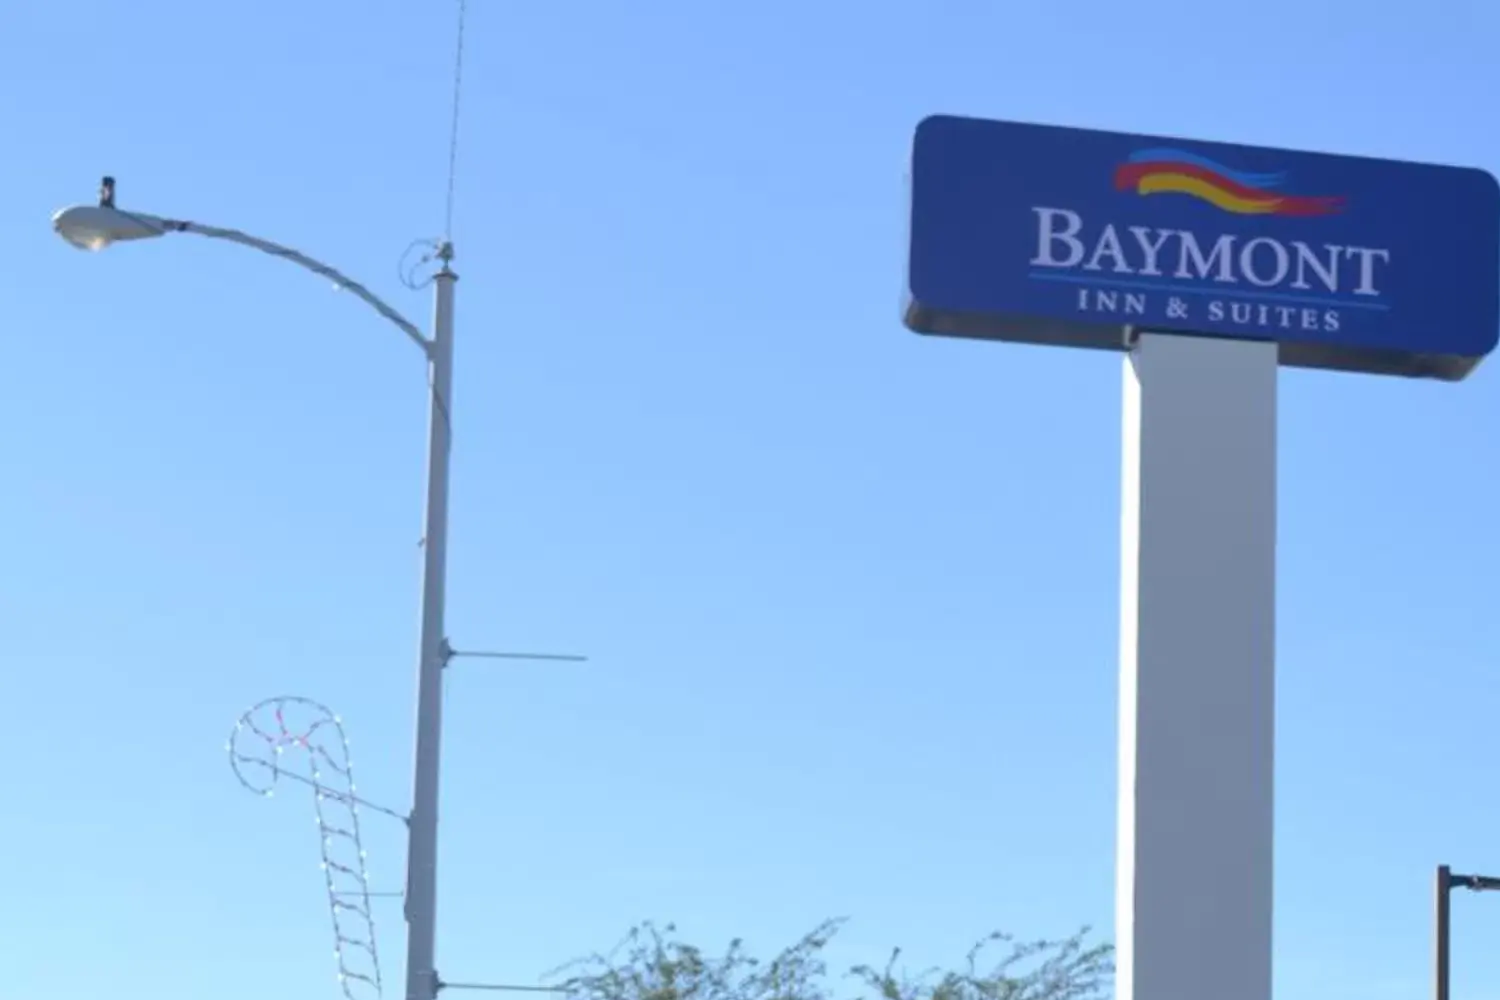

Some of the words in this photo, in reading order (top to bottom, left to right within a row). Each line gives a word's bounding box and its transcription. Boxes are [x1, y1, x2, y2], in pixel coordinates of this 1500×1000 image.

[1029, 206, 1390, 296] BAYMONT
[1078, 289, 1146, 315] INN
[1166, 297, 1189, 320] &
[1209, 301, 1341, 332] SUITES
